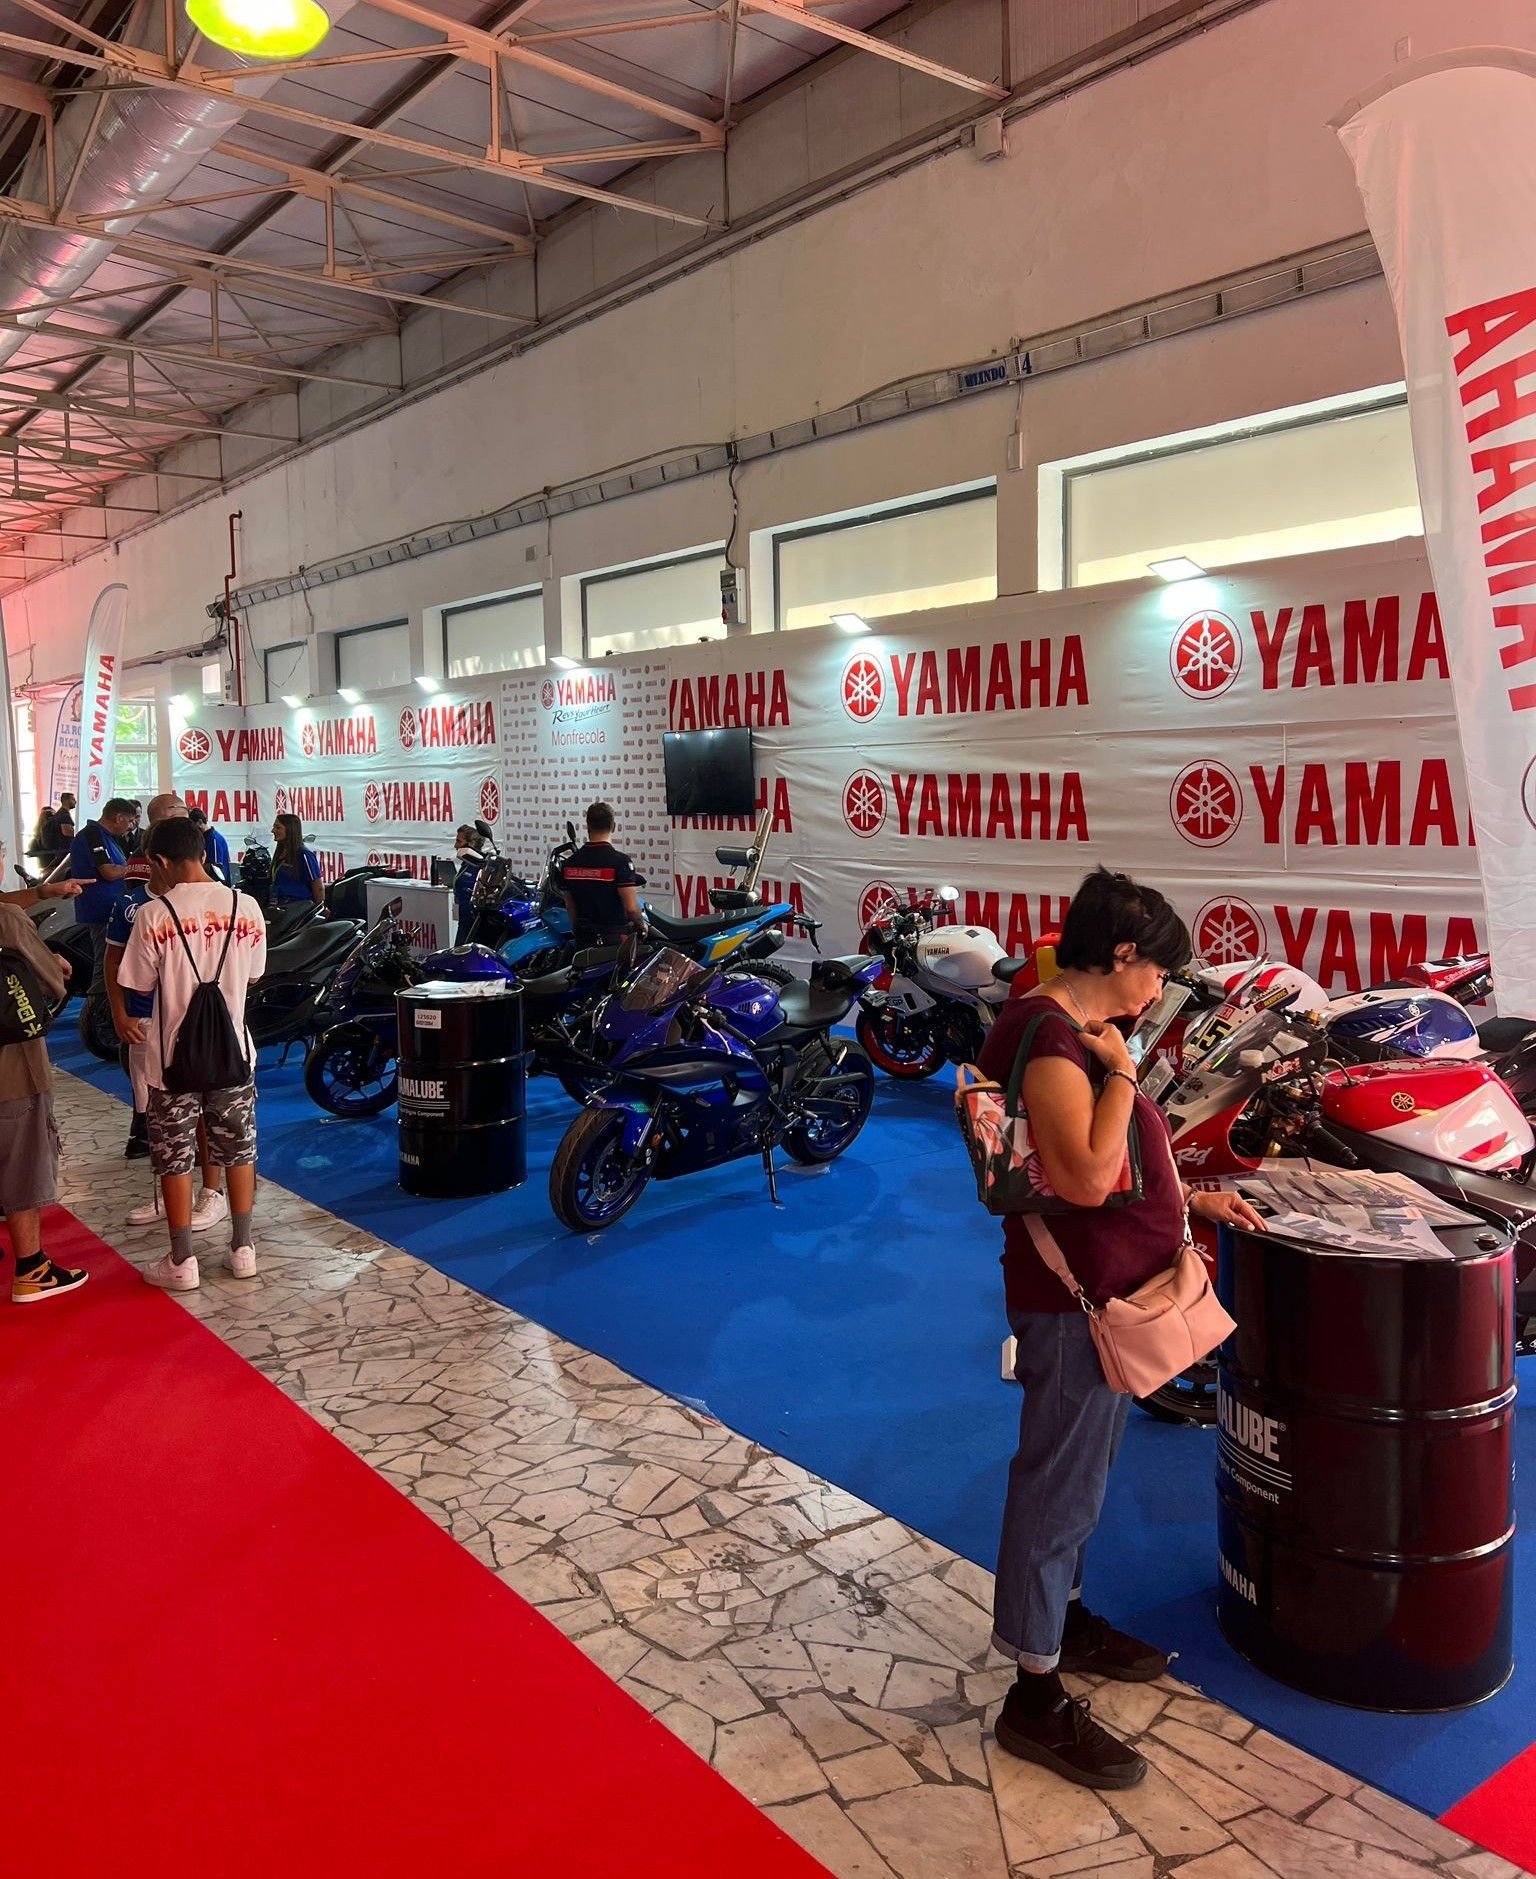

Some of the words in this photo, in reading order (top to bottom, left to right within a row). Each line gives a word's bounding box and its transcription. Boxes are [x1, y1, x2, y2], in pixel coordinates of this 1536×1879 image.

[557, 673, 616, 707] YAMAHA
[890, 634, 1089, 717] YAMAHA
[89, 655, 115, 767] YAMAHA
[419, 701, 496, 747] YAMAHA
[216, 726, 285, 762] YAMAHA
[317, 715, 377, 755] YAMAHA
[551, 728, 606, 747] Monfrecola
[172, 790, 259, 822] MAHA
[289, 786, 344, 822] YAMAHA
[382, 781, 453, 822] YAMAHA
[891, 771, 1090, 842] YAMAHA
[1249, 759, 1476, 847] YAMA
[927, 947, 950, 955] YAMAHA
[1217, 1383, 1280, 1462] ALUBE
[1231, 1467, 1280, 1504] Component
